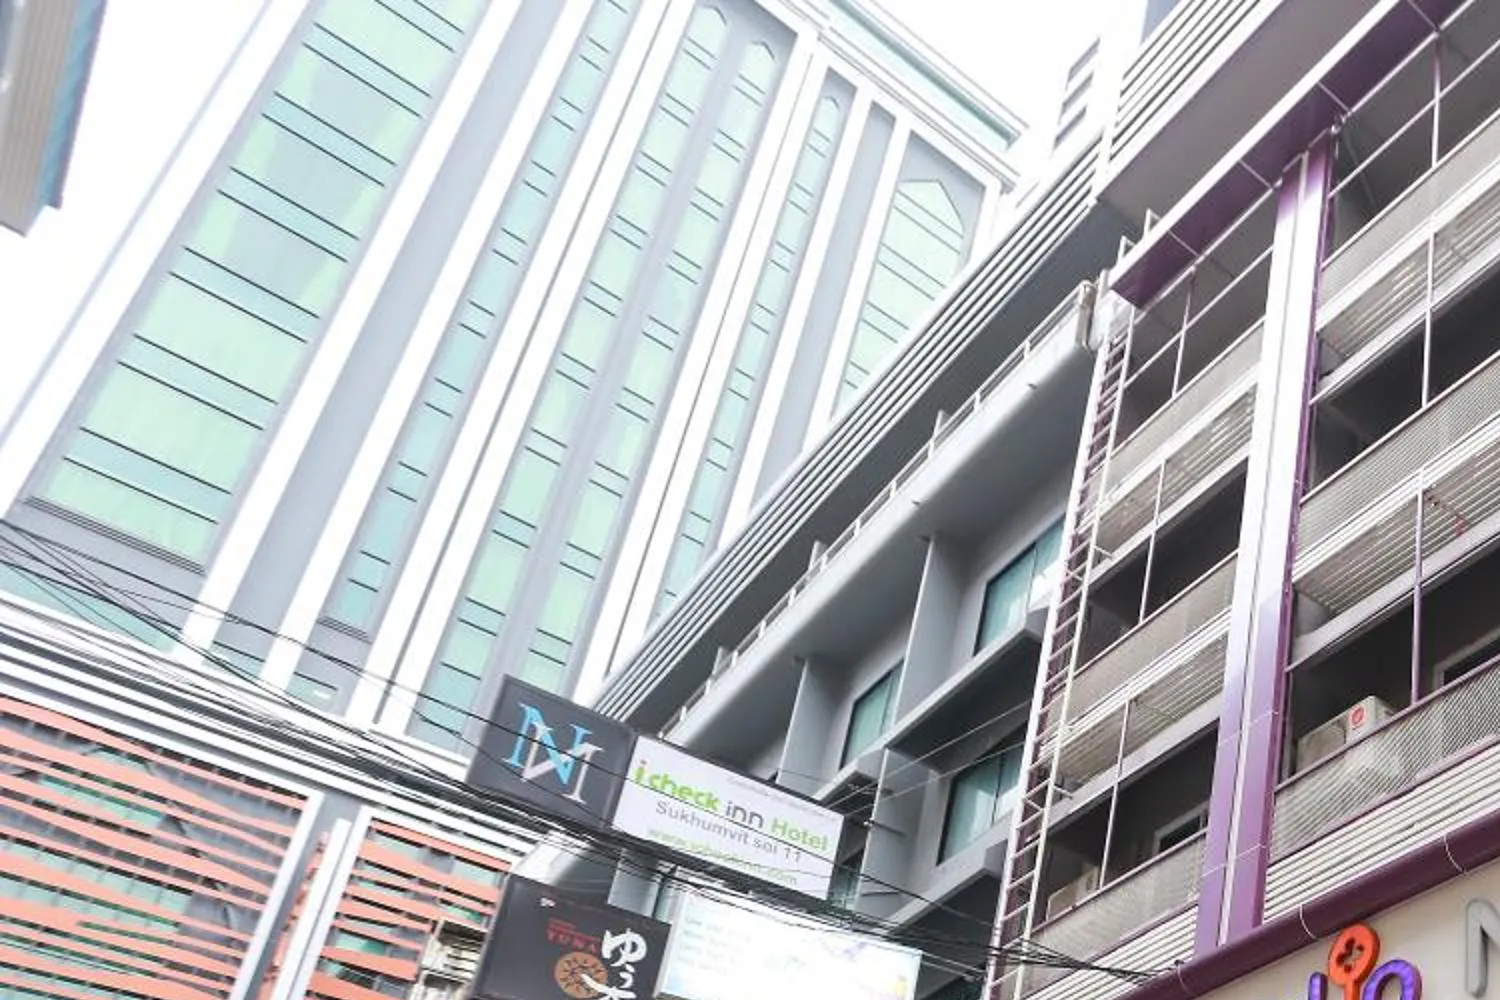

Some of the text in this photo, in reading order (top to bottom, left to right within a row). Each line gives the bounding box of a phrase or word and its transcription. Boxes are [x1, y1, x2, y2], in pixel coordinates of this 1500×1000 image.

[655, 800, 750, 845] Sukhumvit
[725, 801, 764, 829] inn
[771, 816, 829, 851] Hotel
